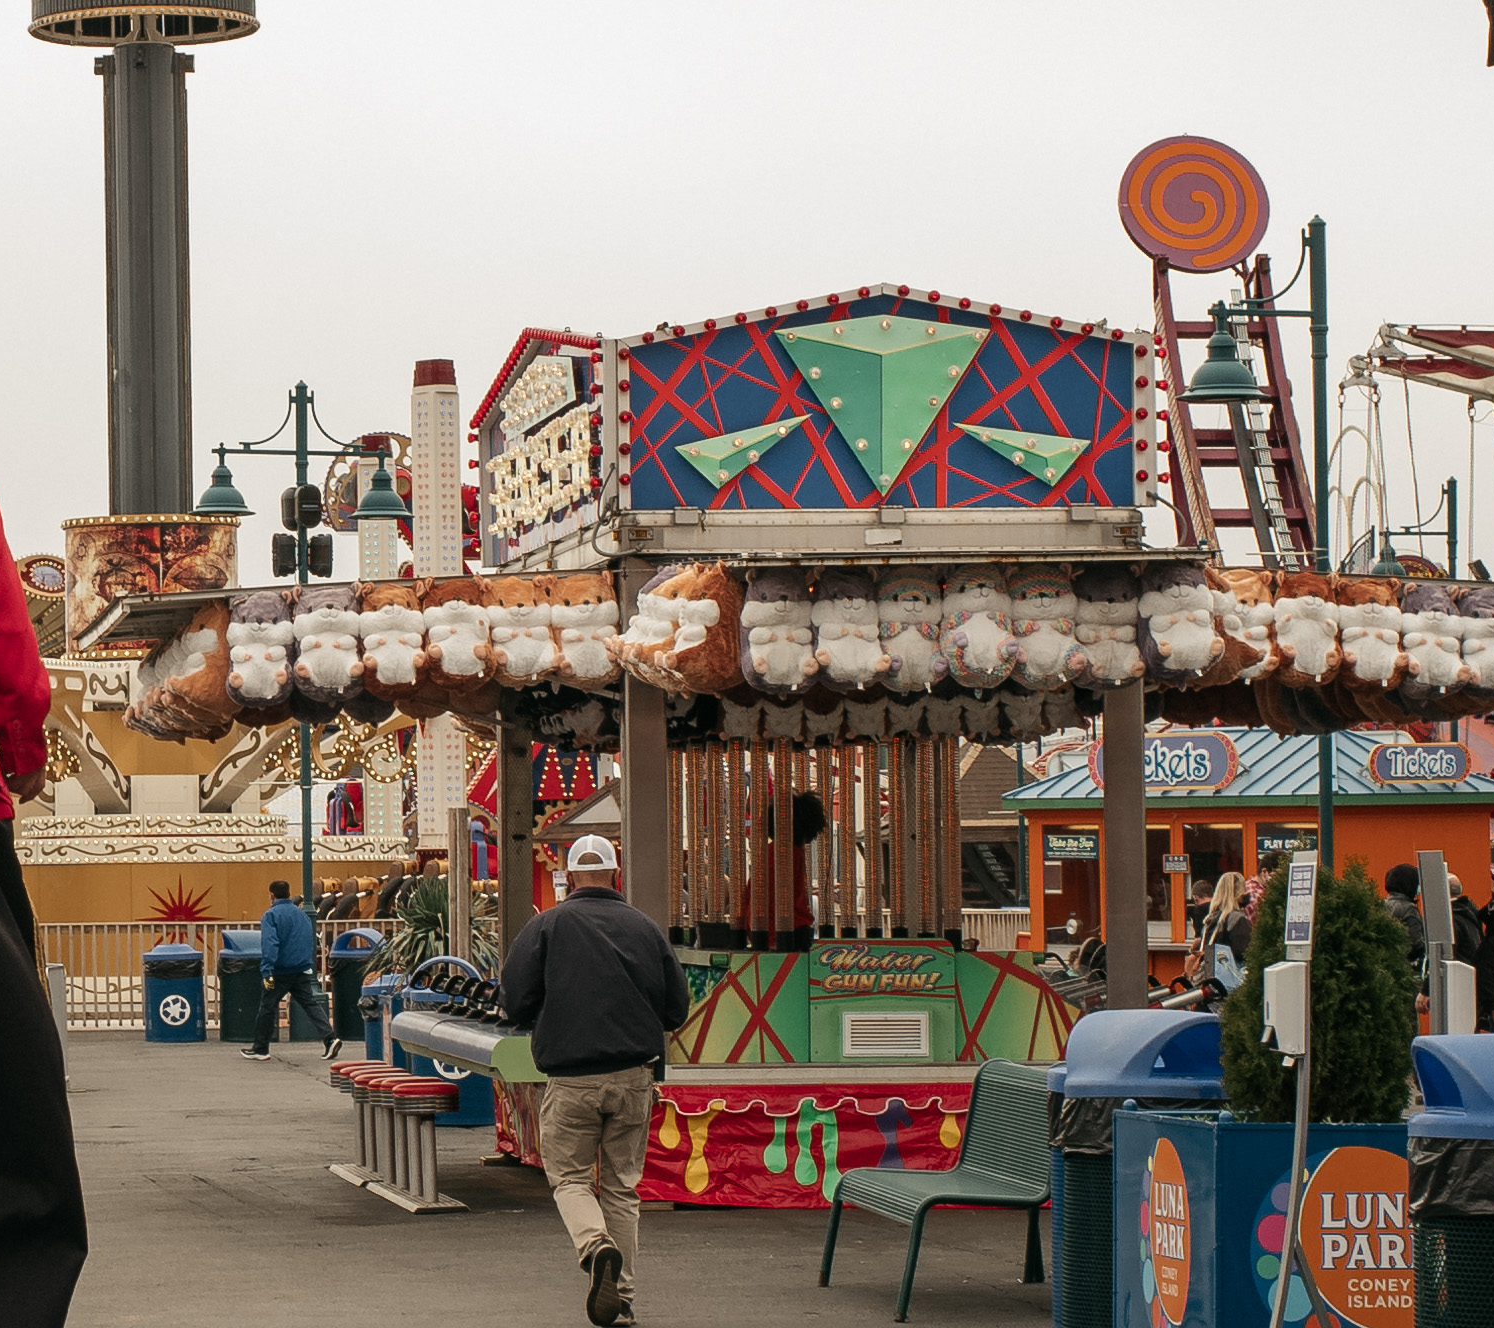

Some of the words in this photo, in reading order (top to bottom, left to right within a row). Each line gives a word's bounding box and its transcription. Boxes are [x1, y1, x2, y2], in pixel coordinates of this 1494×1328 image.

[1144, 739, 1212, 785] ckets
[1387, 746, 1457, 781] Tickets
[820, 943, 935, 972] Water
[822, 972, 878, 992] GUN
[877, 972, 942, 992] FUN!
[1154, 1181, 1185, 1221] LUNA
[1320, 1192, 1414, 1230] LUN
[1154, 1221, 1185, 1261] PARK
[1320, 1234, 1414, 1270] PAR
[1161, 1267, 1178, 1281] CONEY
[1161, 1281, 1179, 1298] ISLAND
[1348, 1278, 1411, 1292] CONEY
[1348, 1294, 1414, 1309] ISLAND
